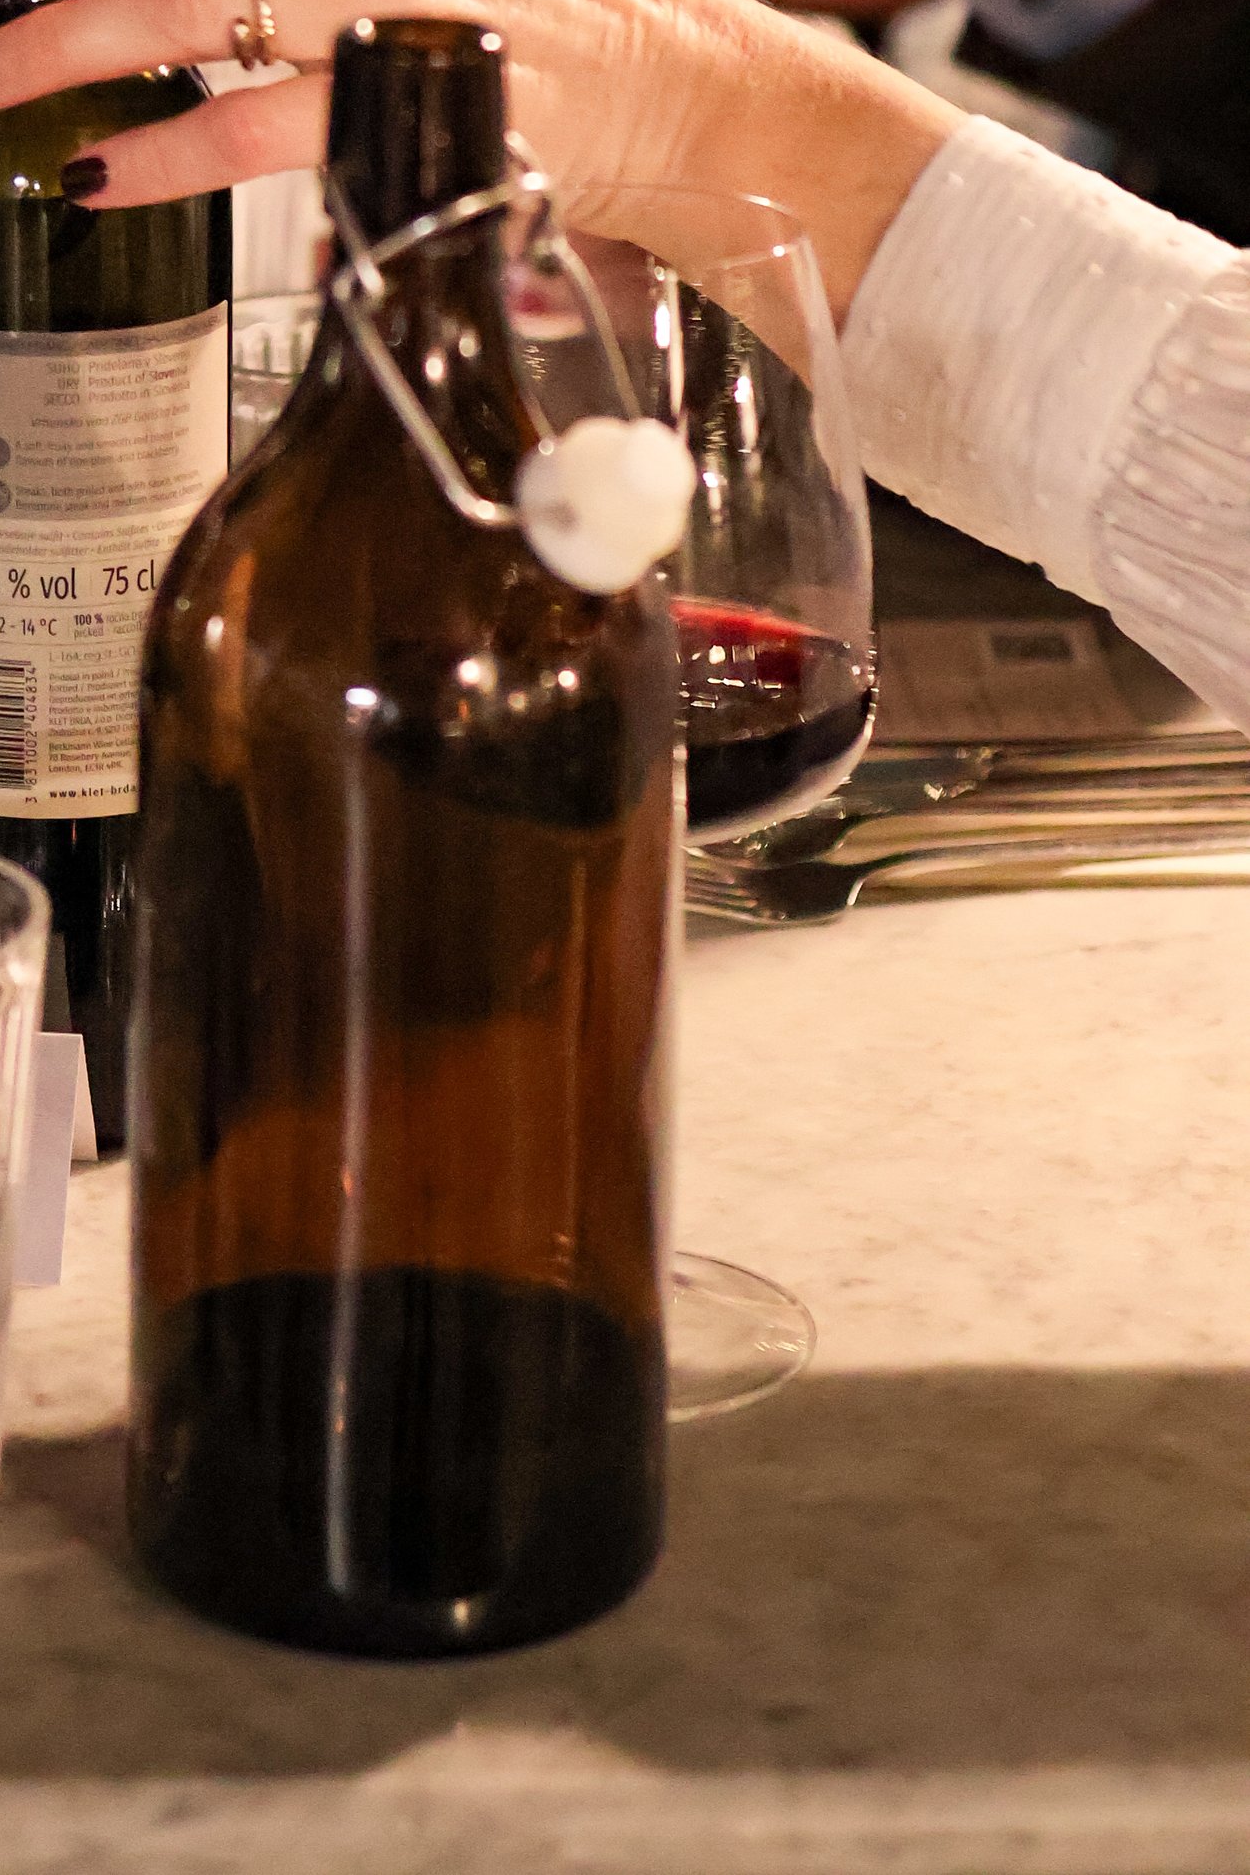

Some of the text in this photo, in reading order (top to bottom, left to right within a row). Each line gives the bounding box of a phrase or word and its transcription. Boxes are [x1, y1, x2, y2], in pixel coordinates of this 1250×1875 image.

[88, 365, 188, 388] Product of Slovenia
[8, 568, 31, 599] %
[40, 567, 77, 599] vol
[102, 565, 129, 596] 75
[137, 559, 156, 592] cl
[21, 618, 35, 636] 14
[39, 617, 58, 636] °C
[73, 613, 92, 626] 100
[93, 613, 104, 625] %
[73, 627, 104, 641] picked
[25, 667, 37, 722] 404834
[25, 730, 37, 786] 831002
[24, 796, 38, 804] 3
[49, 783, 138, 799] www.klet-brda
